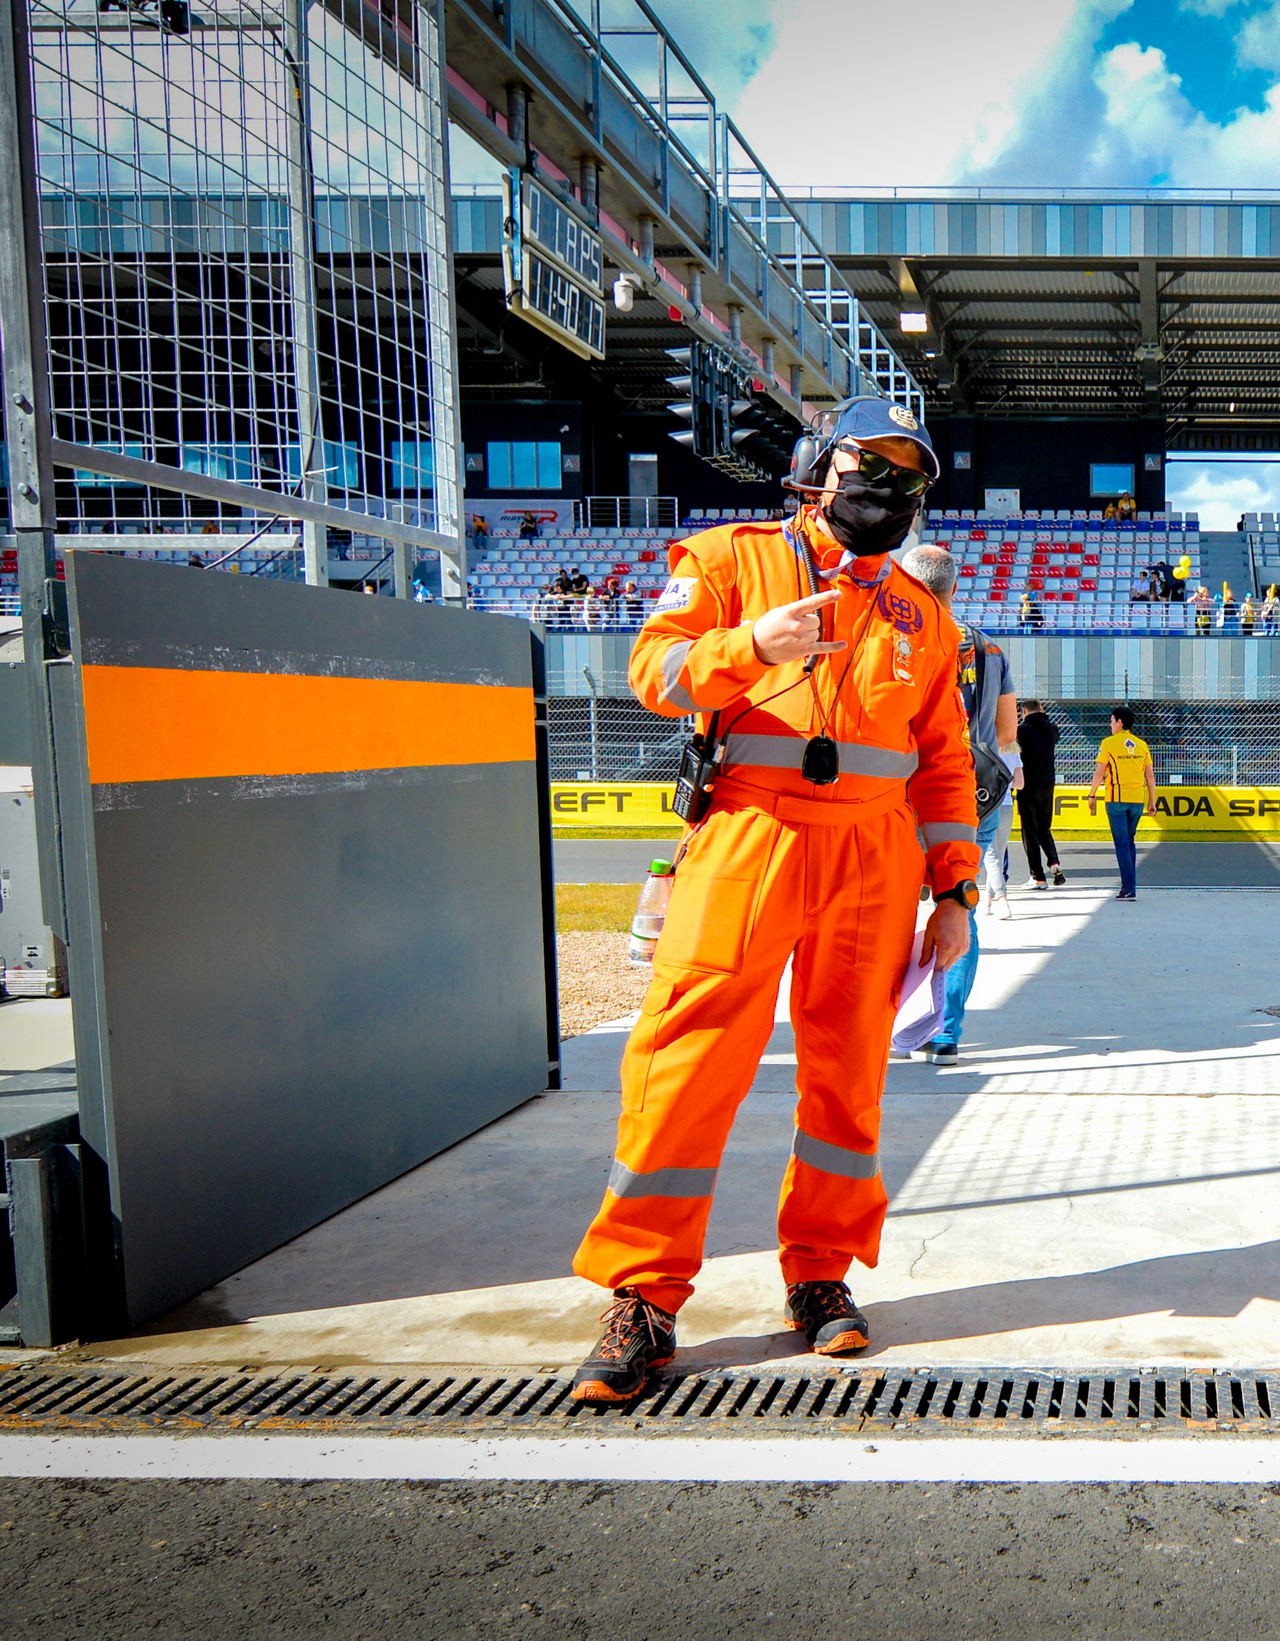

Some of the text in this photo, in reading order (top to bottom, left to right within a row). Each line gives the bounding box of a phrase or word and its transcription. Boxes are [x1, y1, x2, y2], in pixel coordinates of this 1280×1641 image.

[555, 207, 601, 290] LAPS
[955, 455, 970, 466] A5
[553, 792, 632, 812] EFT
[1142, 796, 1215, 817] ADA
